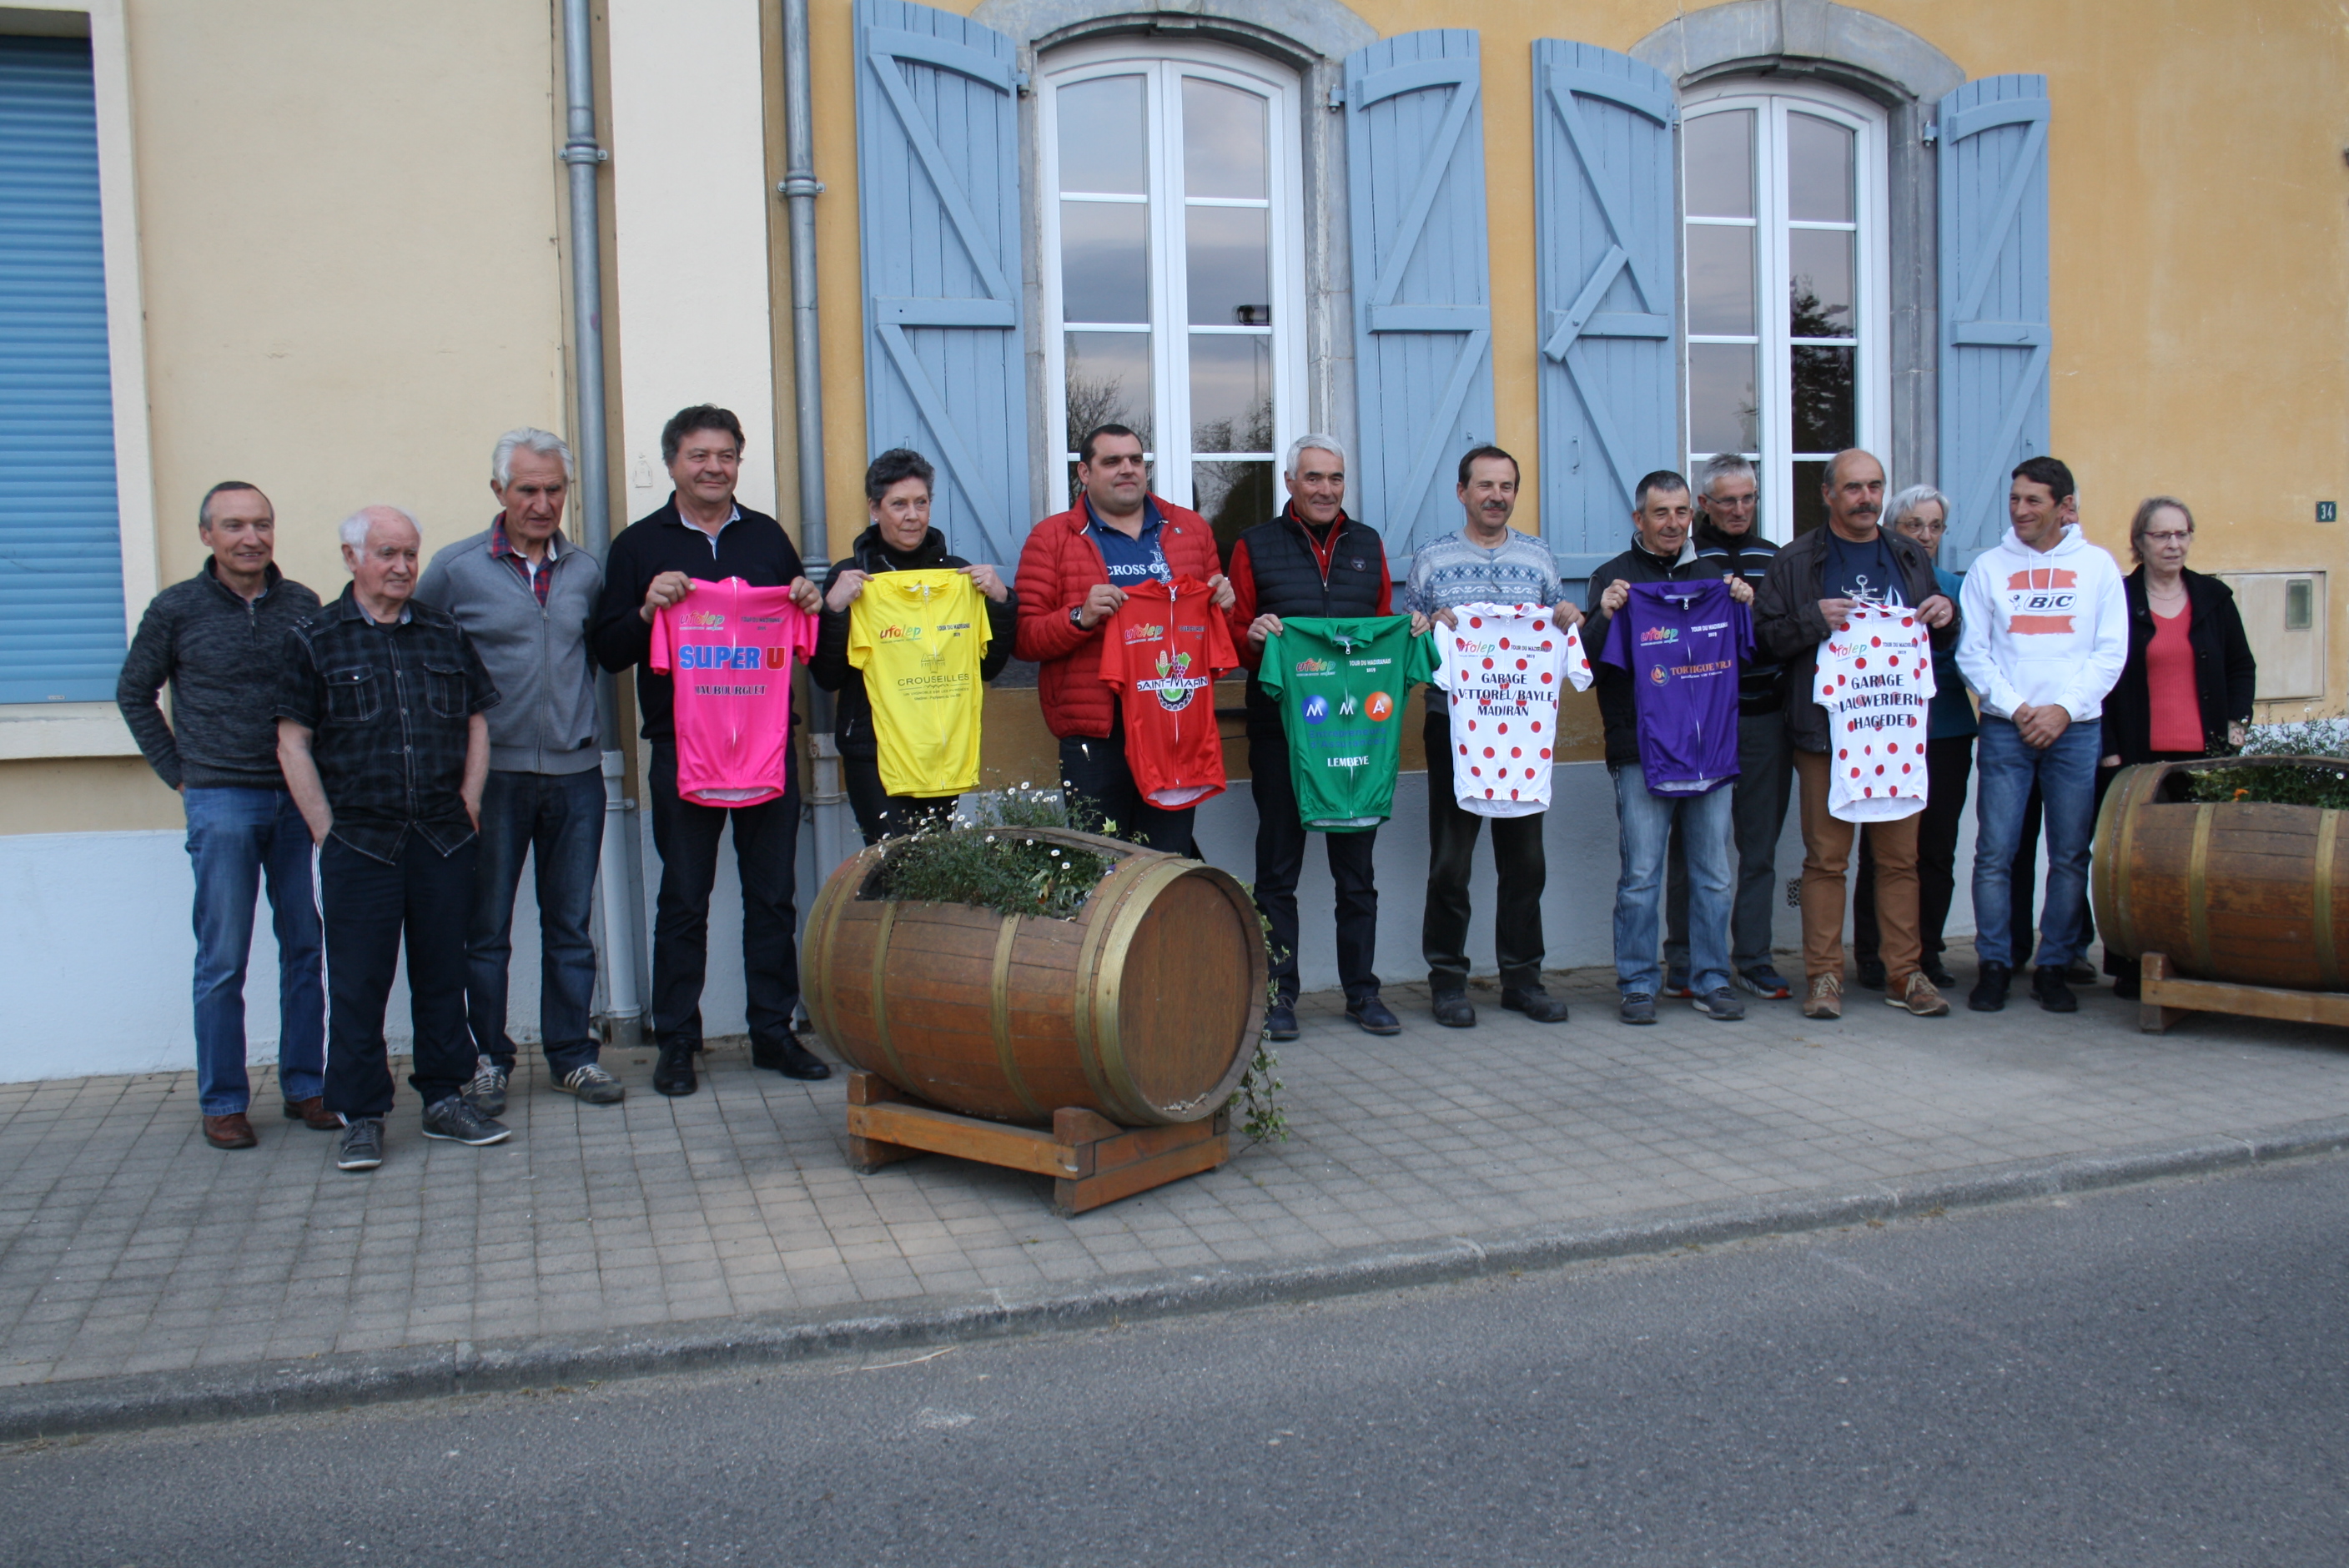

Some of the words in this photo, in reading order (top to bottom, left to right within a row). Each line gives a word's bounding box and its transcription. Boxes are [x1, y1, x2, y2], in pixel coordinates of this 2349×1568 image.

[2321, 504, 2332, 520] 34
[880, 624, 921, 640] ufolep
[678, 644, 762, 670] SUPER
[766, 646, 786, 671] U
[1670, 663, 1713, 676] TORTIGUE
[898, 673, 969, 686] CROUSEILLES
[1481, 673, 1527, 685] GARAGE
[1851, 674, 1904, 690] GARAGE
[1477, 705, 1529, 716] MADIRAN
[1854, 714, 1914, 730] HAGEDET
[1310, 727, 1386, 739] Entrepreneurs
[1310, 738, 1386, 749] d'Assurances
[1327, 756, 1369, 767] LEMBEYE
